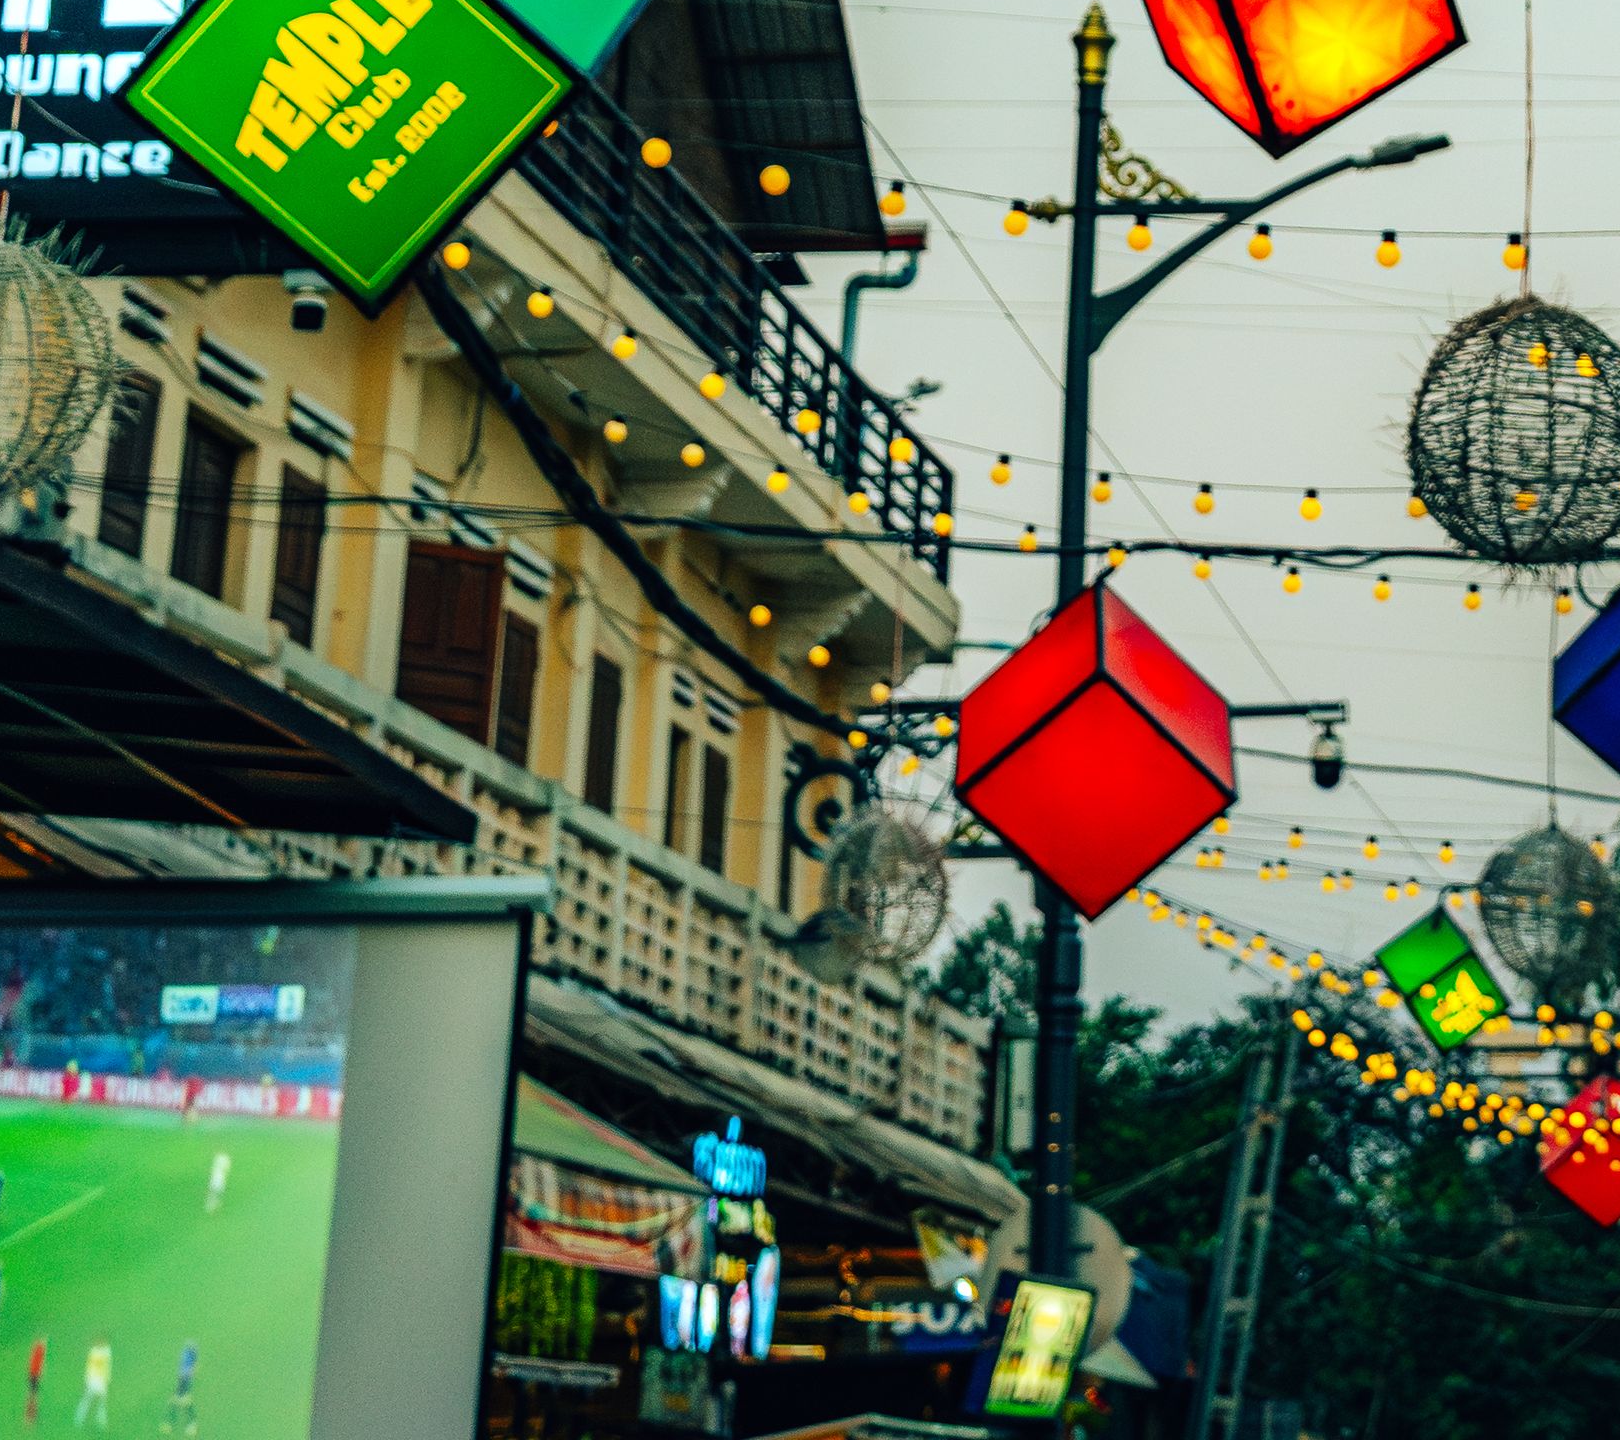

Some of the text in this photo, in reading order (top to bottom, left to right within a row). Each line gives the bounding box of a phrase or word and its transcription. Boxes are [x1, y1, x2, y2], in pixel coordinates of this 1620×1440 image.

[325, 67, 412, 150] Club
[347, 80, 467, 203] Est. 2008
